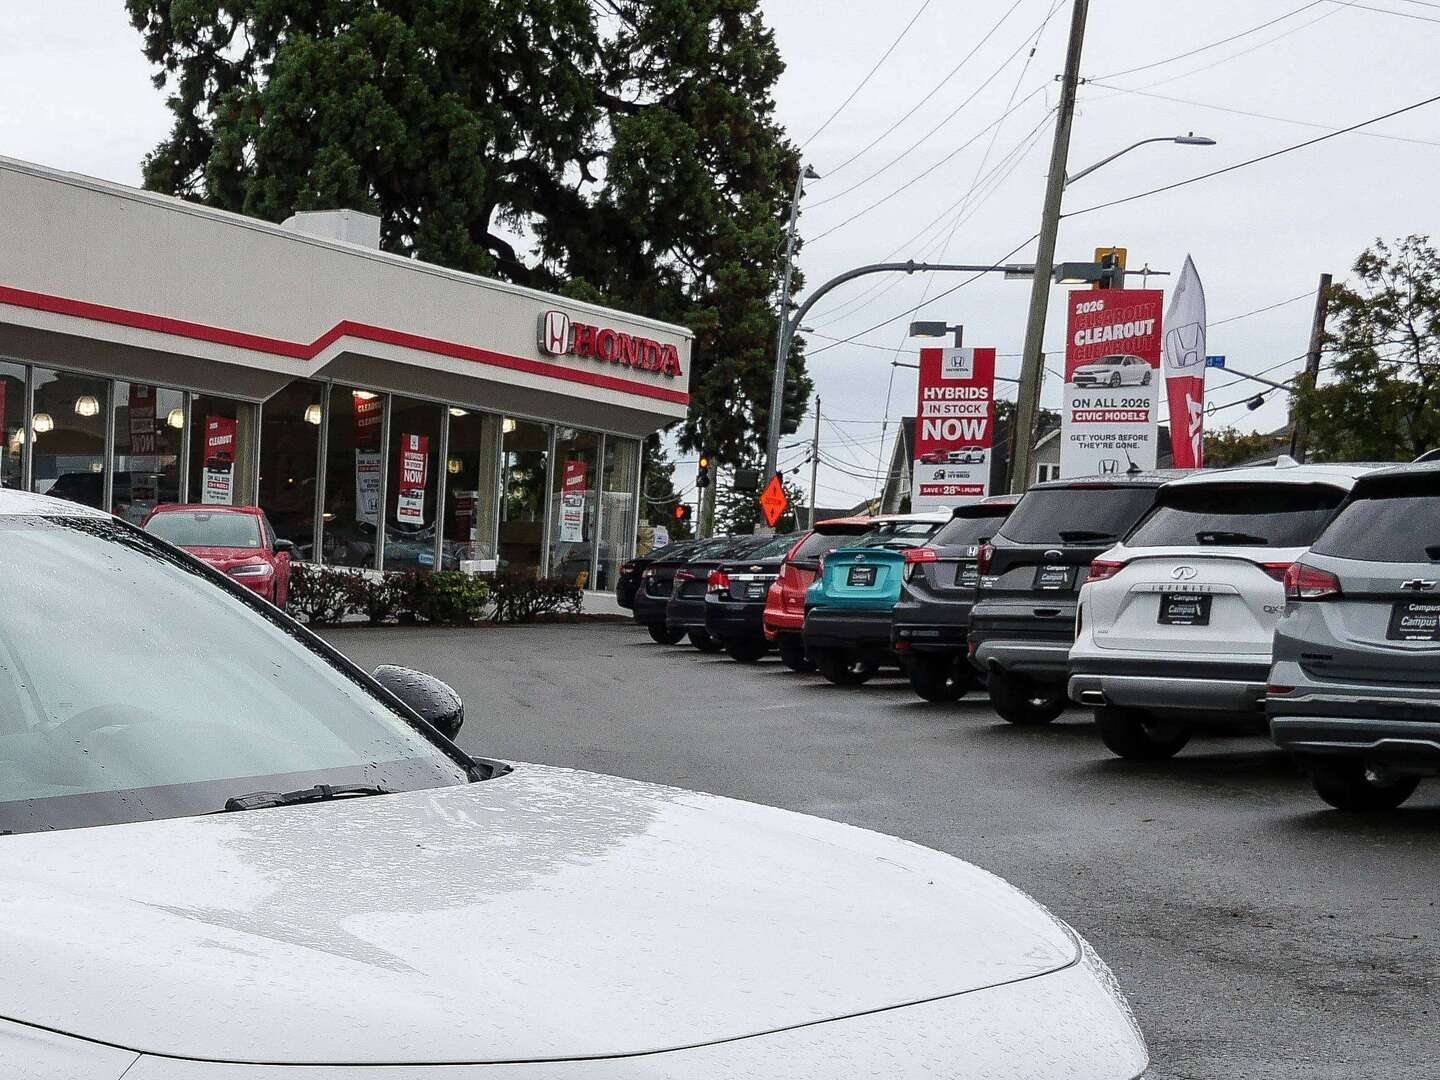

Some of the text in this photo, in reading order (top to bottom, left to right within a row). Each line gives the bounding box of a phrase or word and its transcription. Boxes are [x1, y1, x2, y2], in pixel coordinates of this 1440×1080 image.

[1076, 300, 1104, 315] 2026
[1074, 319, 1155, 346] CLEAROUT
[572, 322, 683, 377] HONDA
[923, 387, 989, 399] HYBRIDS
[929, 404, 981, 414] IN STOCK
[1072, 399, 1150, 408] ON ALL 2026
[1075, 412, 1146, 420] CIVIC MODELS
[922, 418, 988, 441] NOW
[403, 470, 423, 483] NOW
[1409, 603, 1440, 613] Campus
[1401, 616, 1436, 628] Campus
